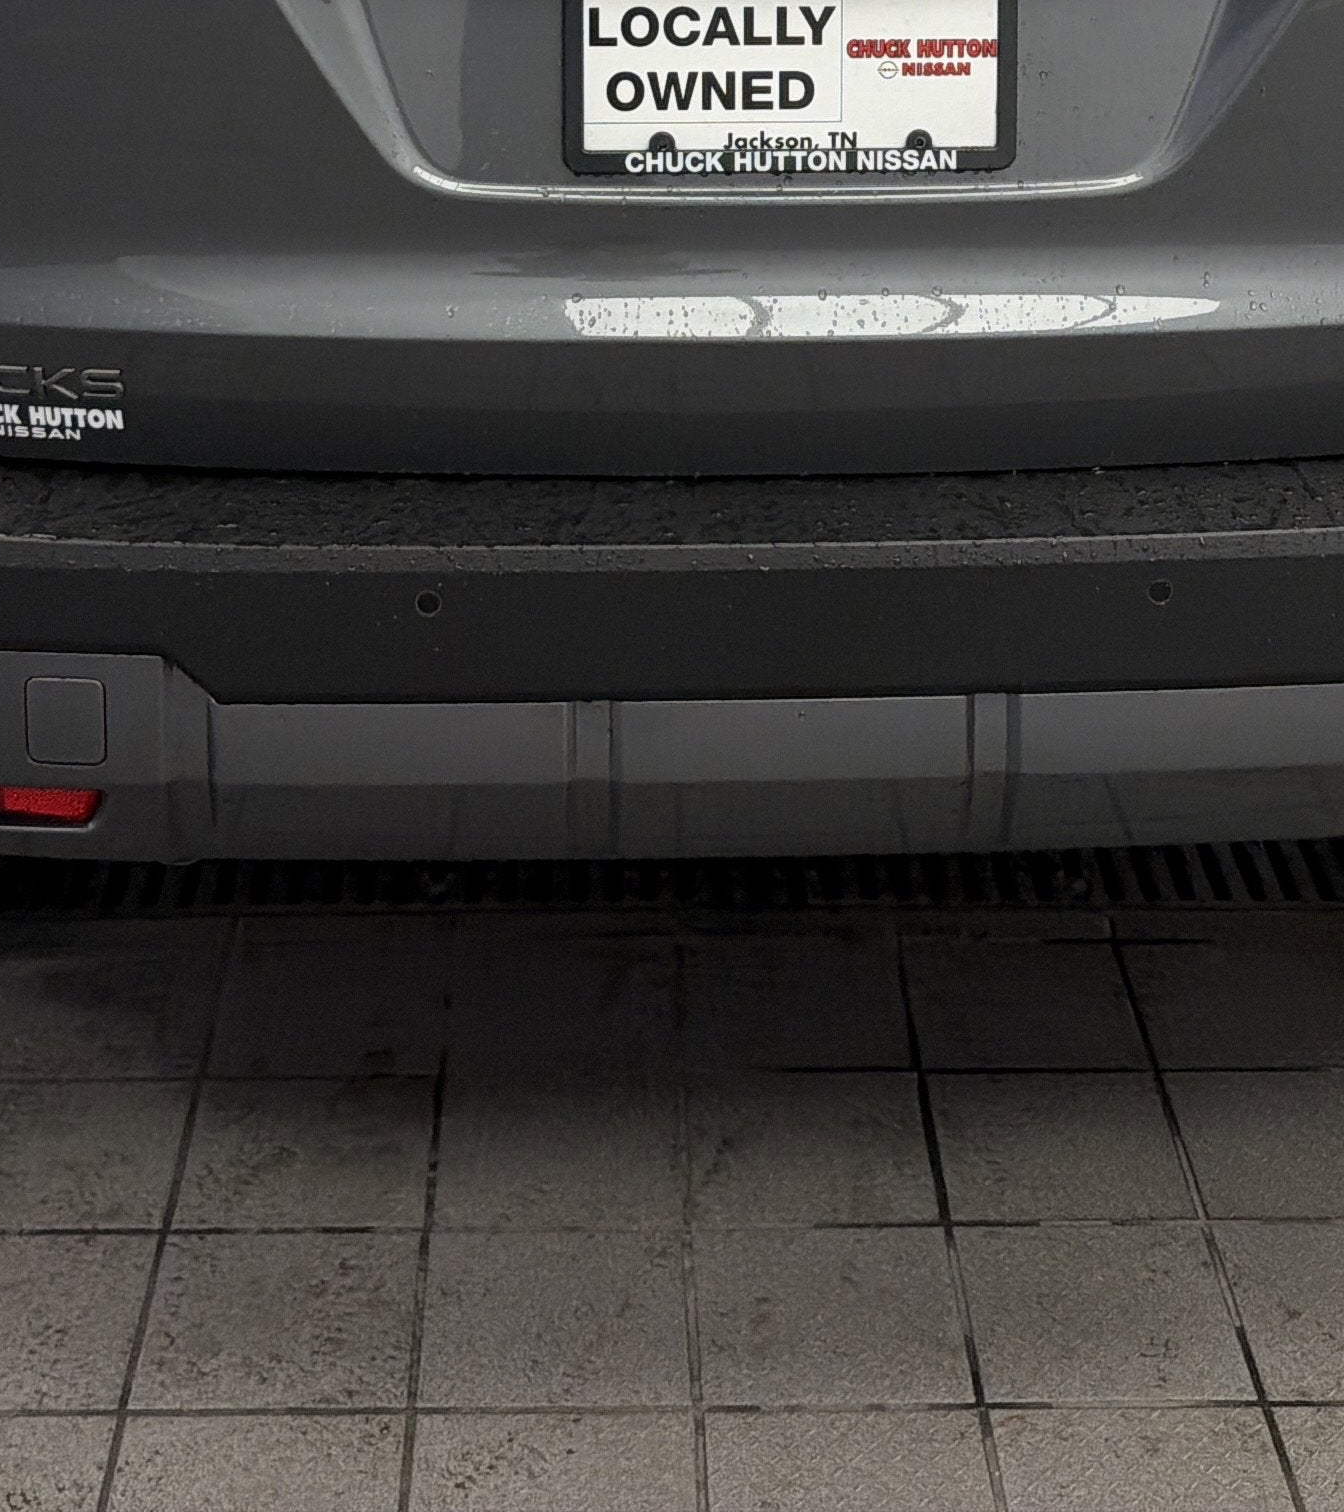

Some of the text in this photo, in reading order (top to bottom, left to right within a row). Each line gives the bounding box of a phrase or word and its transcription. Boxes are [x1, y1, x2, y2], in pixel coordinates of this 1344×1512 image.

[588, 5, 837, 48] LOCALLY
[846, 38, 998, 59] CHUCK HUTTON
[901, 62, 971, 77] NISSAN
[605, 71, 815, 111] OWNED
[723, 131, 858, 150] Jackson, TN
[624, 149, 958, 173] CHUCK HUTTON NISSAN
[28, 405, 124, 430] HUTTON
